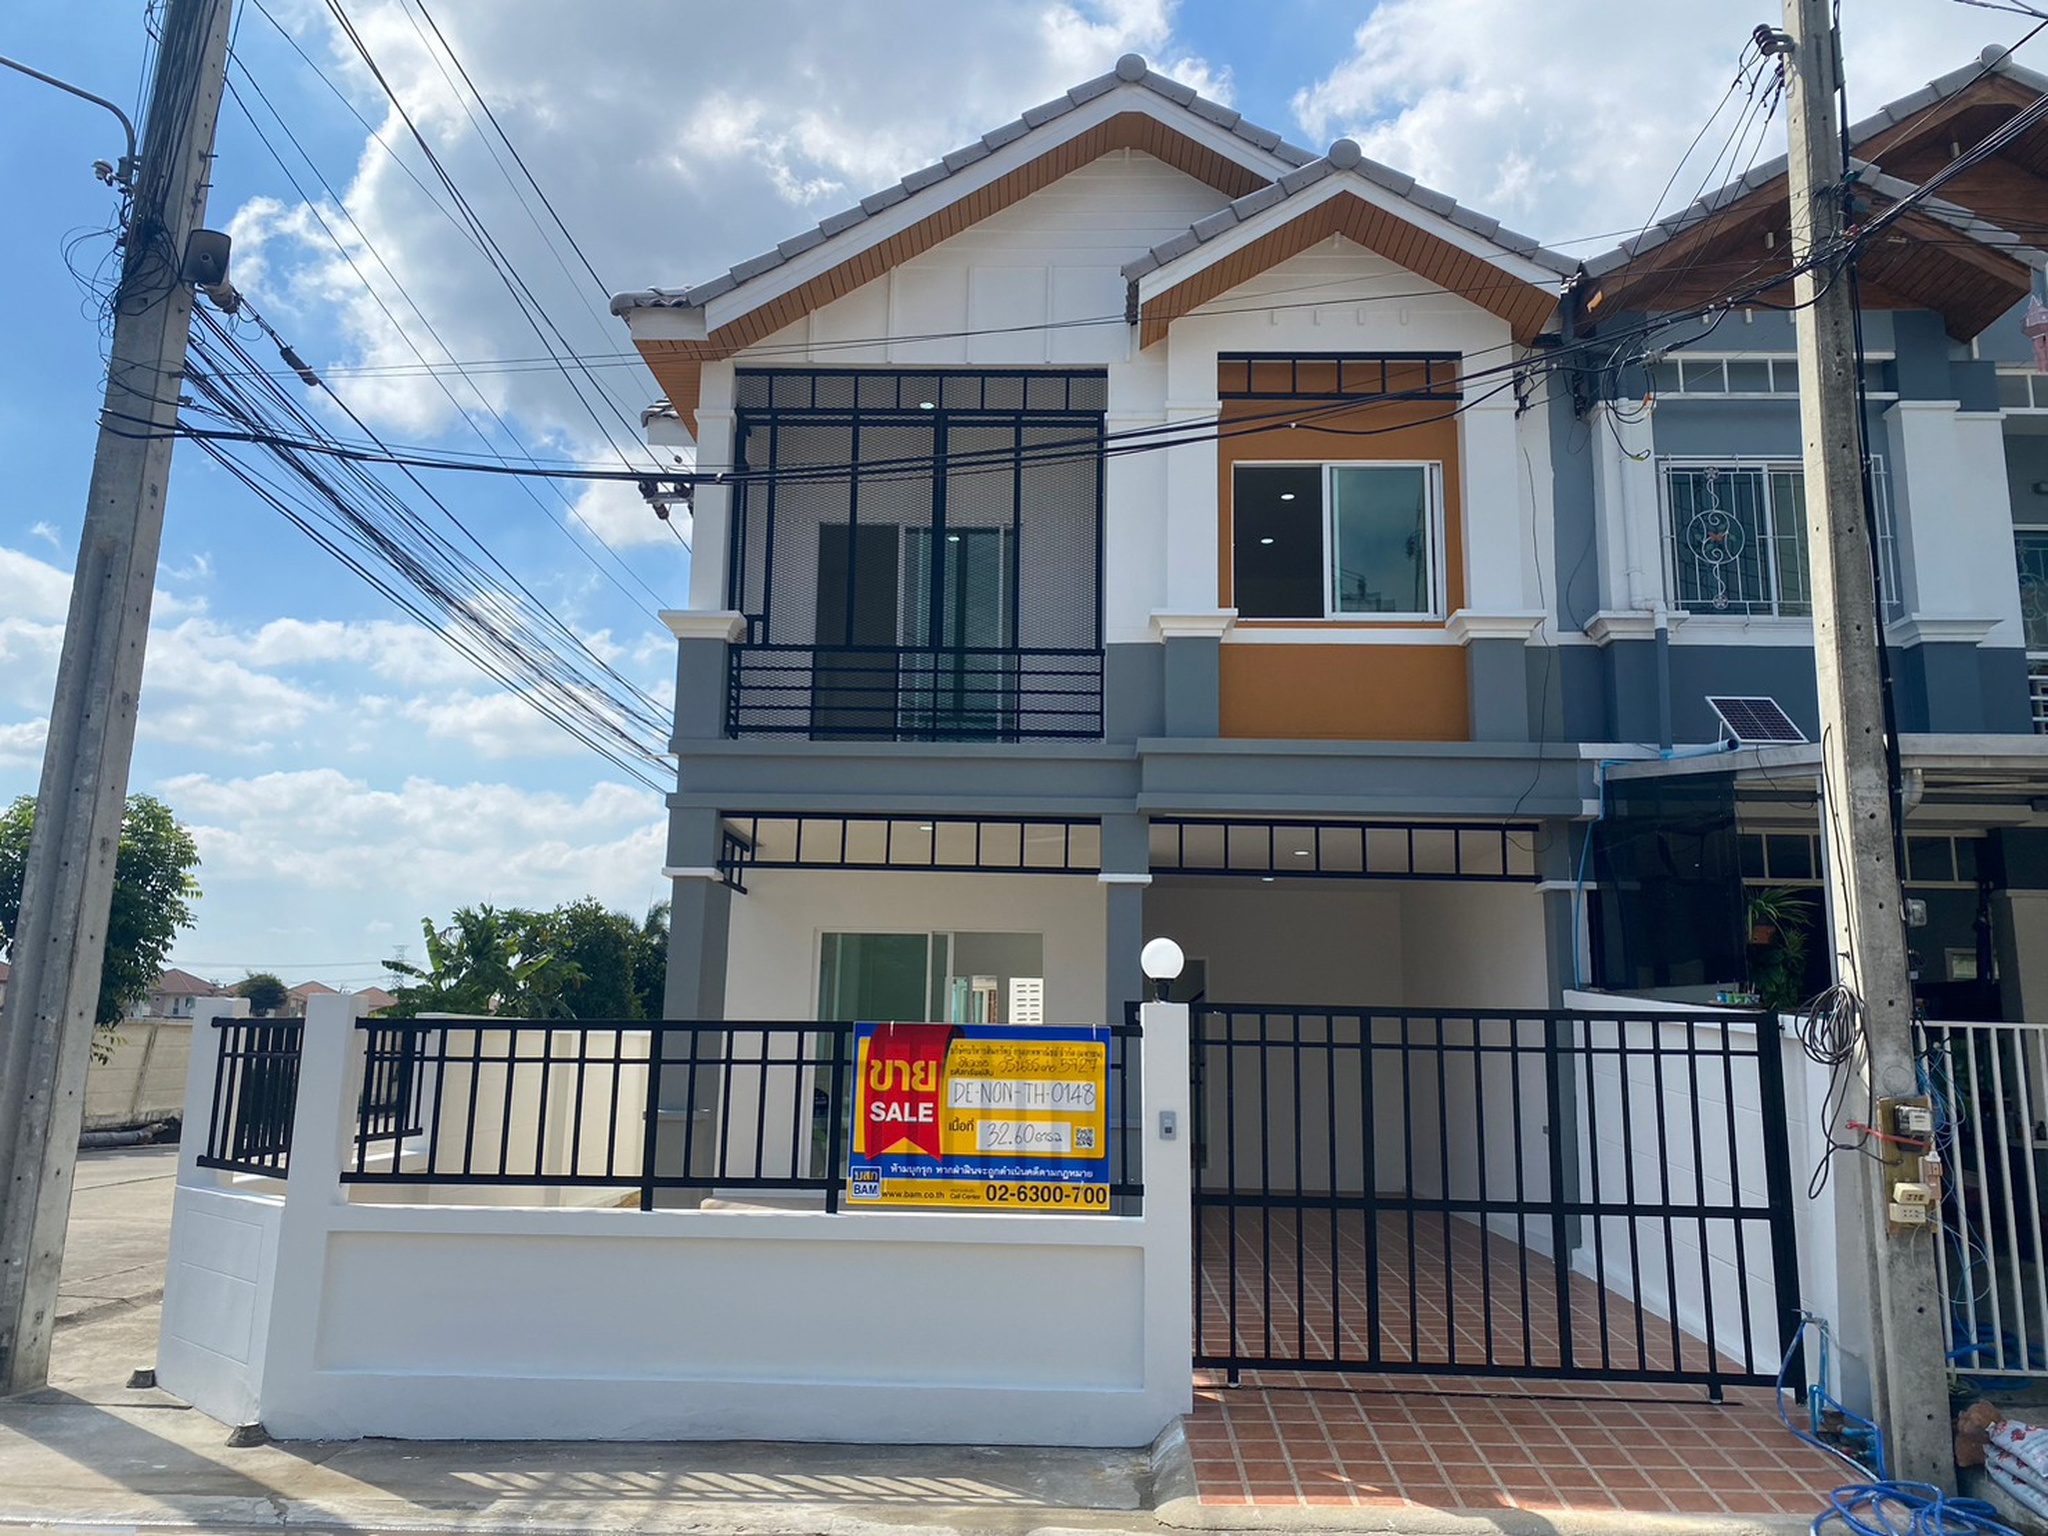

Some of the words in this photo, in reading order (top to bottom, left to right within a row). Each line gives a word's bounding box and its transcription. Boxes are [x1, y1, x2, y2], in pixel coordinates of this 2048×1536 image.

[870, 1060, 937, 1092] ขาย
[870, 1101, 934, 1123] SALE
[854, 1170, 878, 1181] บสก
[853, 1184, 878, 1195] BAM
[882, 1189, 945, 1199] www.bam.co.th
[986, 1184, 1107, 1204] 02-6300-700
